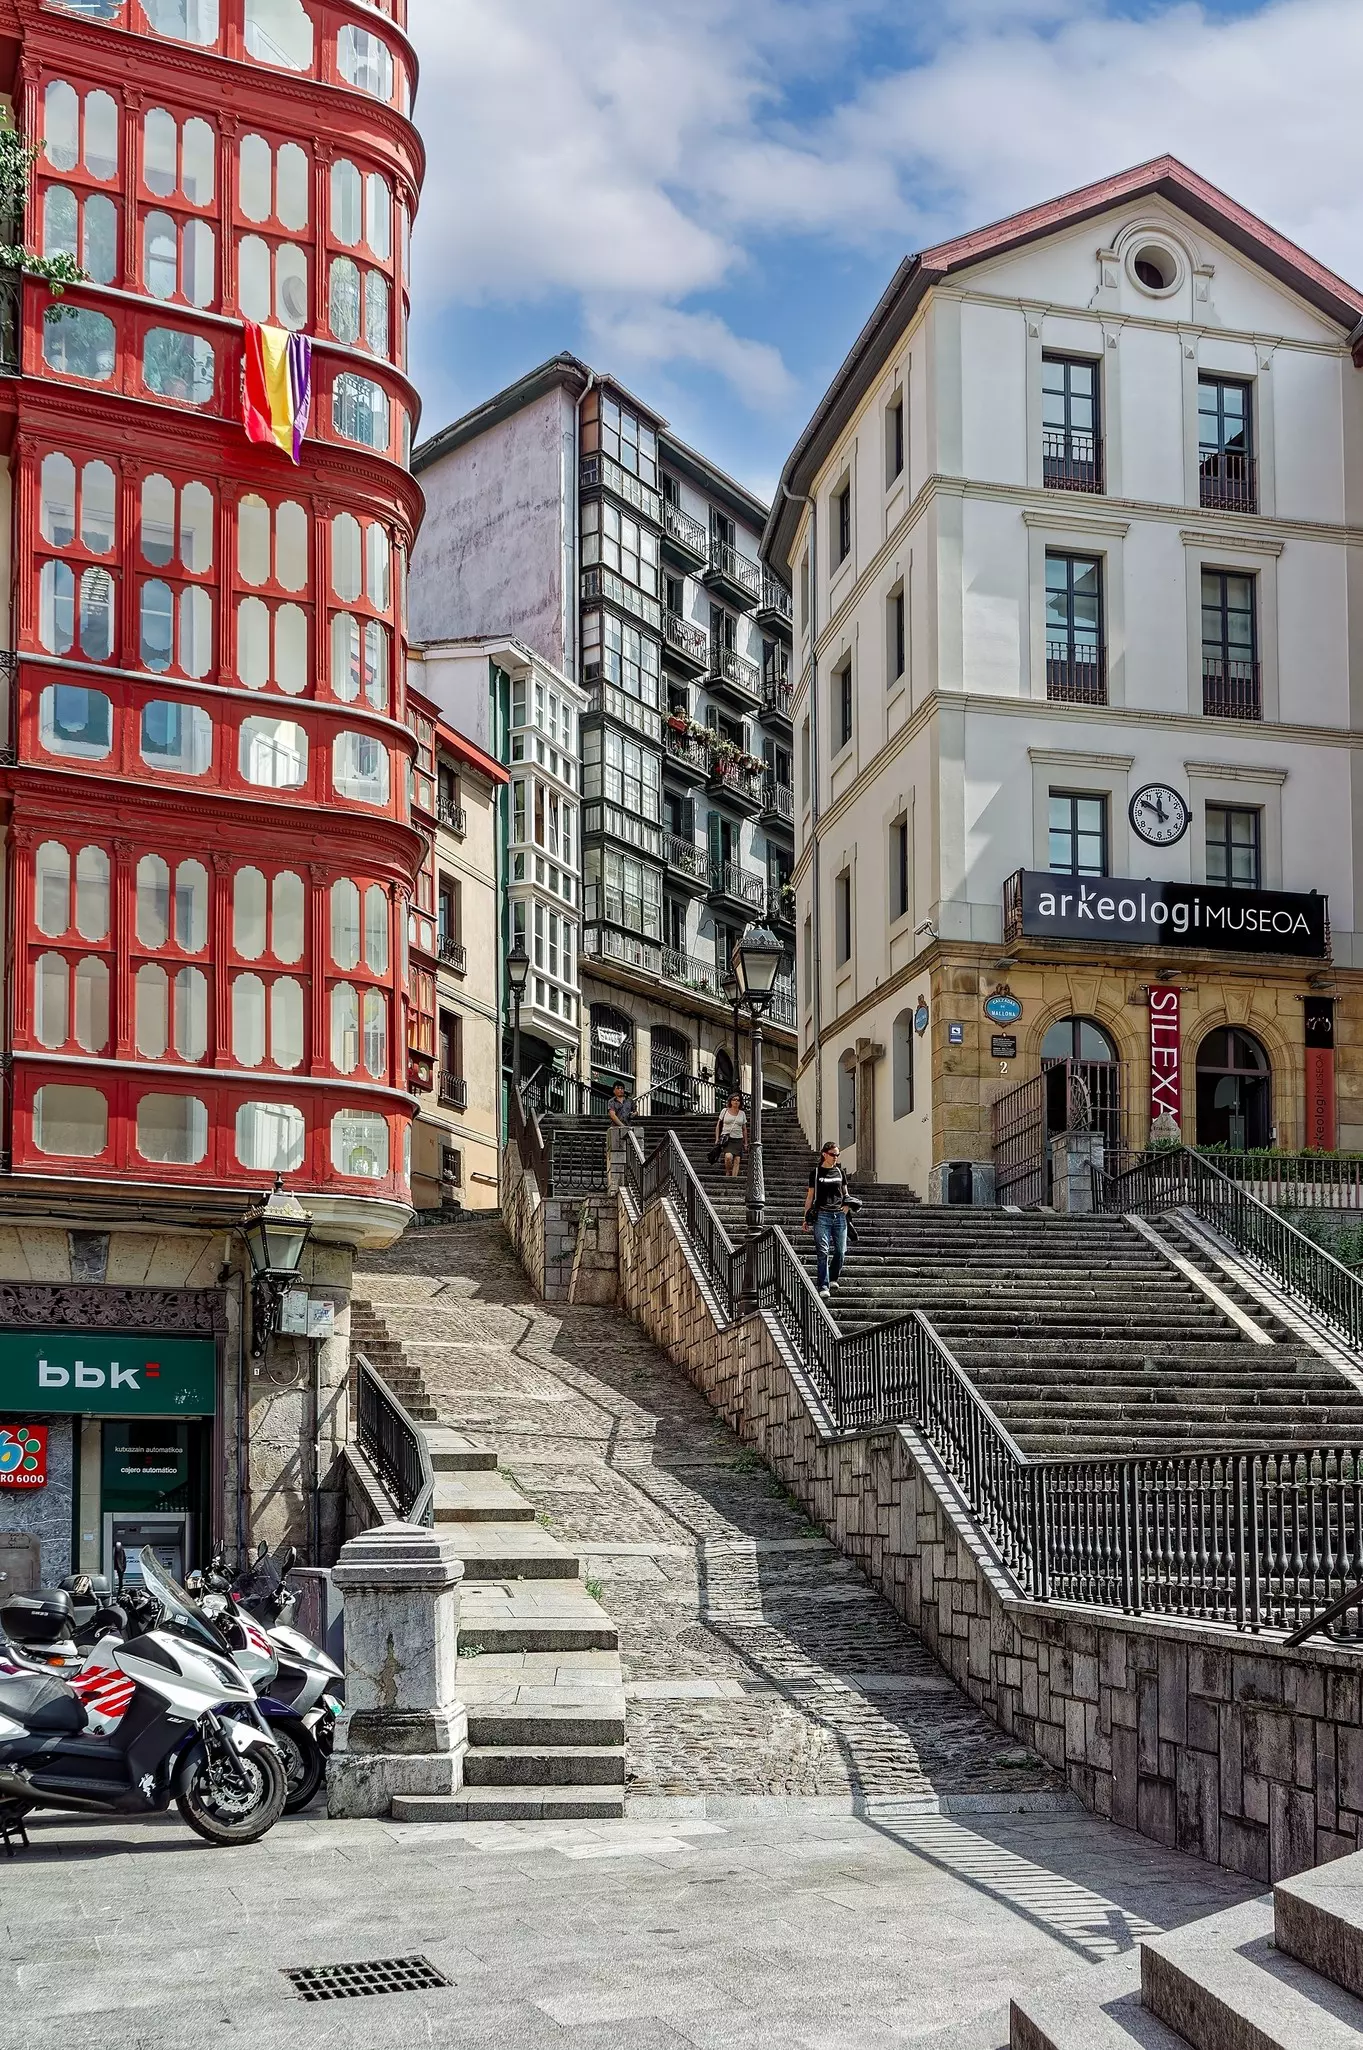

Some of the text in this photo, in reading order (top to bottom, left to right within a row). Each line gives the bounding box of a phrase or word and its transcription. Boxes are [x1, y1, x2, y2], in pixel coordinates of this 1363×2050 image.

[1176, 812, 1181, 820] 3
[1038, 884, 1311, 935] arkeologi MUSEOA
[1000, 1061, 1007, 1073] 2
[39, 1360, 141, 1389] bbk
[120, 1466, 141, 1474] cajero
[16, 1474, 44, 1483] 6000
